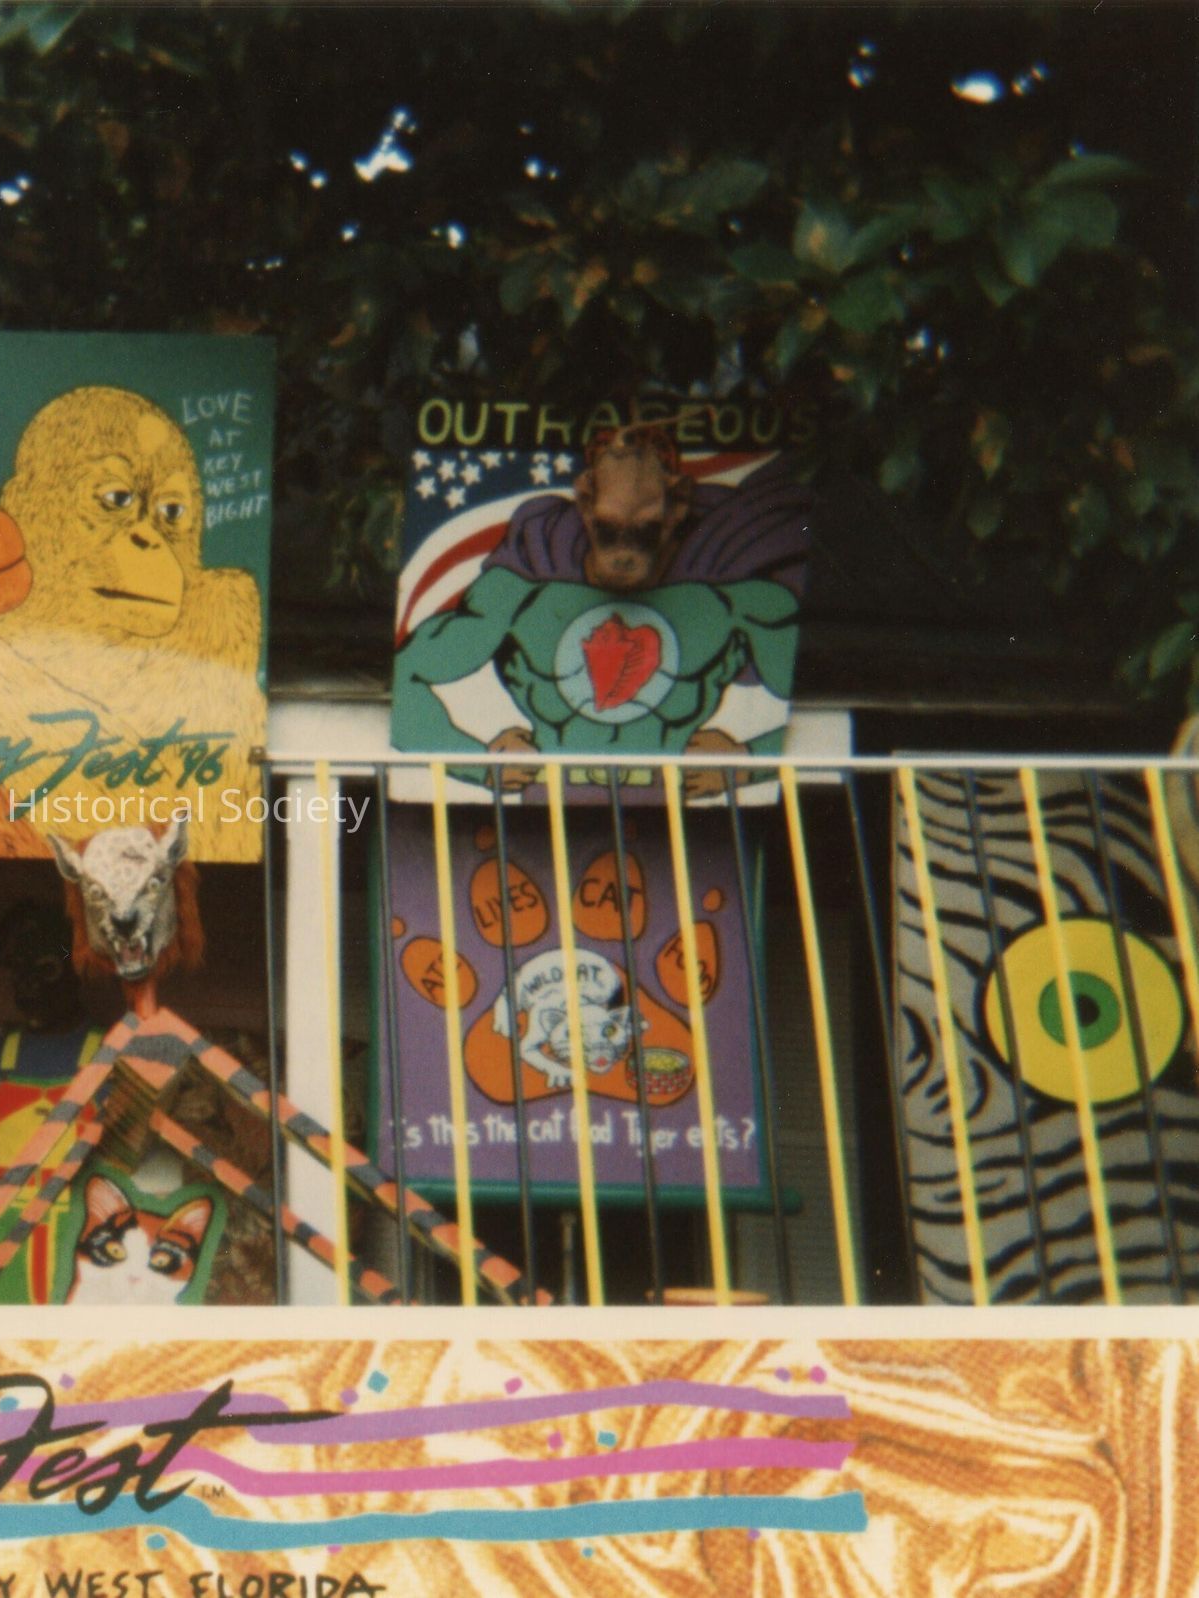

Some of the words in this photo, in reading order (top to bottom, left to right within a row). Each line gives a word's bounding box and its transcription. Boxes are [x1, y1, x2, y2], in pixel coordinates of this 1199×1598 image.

[182, 391, 253, 425] LOVE
[417, 397, 817, 447] OUTRAEOUS
[208, 428, 242, 448] AT
[203, 452, 243, 475] KEY
[205, 468, 264, 498] WEST
[13, 709, 236, 818] Fest
[474, 880, 539, 929] LIES
[580, 878, 641, 913] CAT
[427, 1114, 481, 1147] ths
[685, 1114, 756, 1149] ets?
